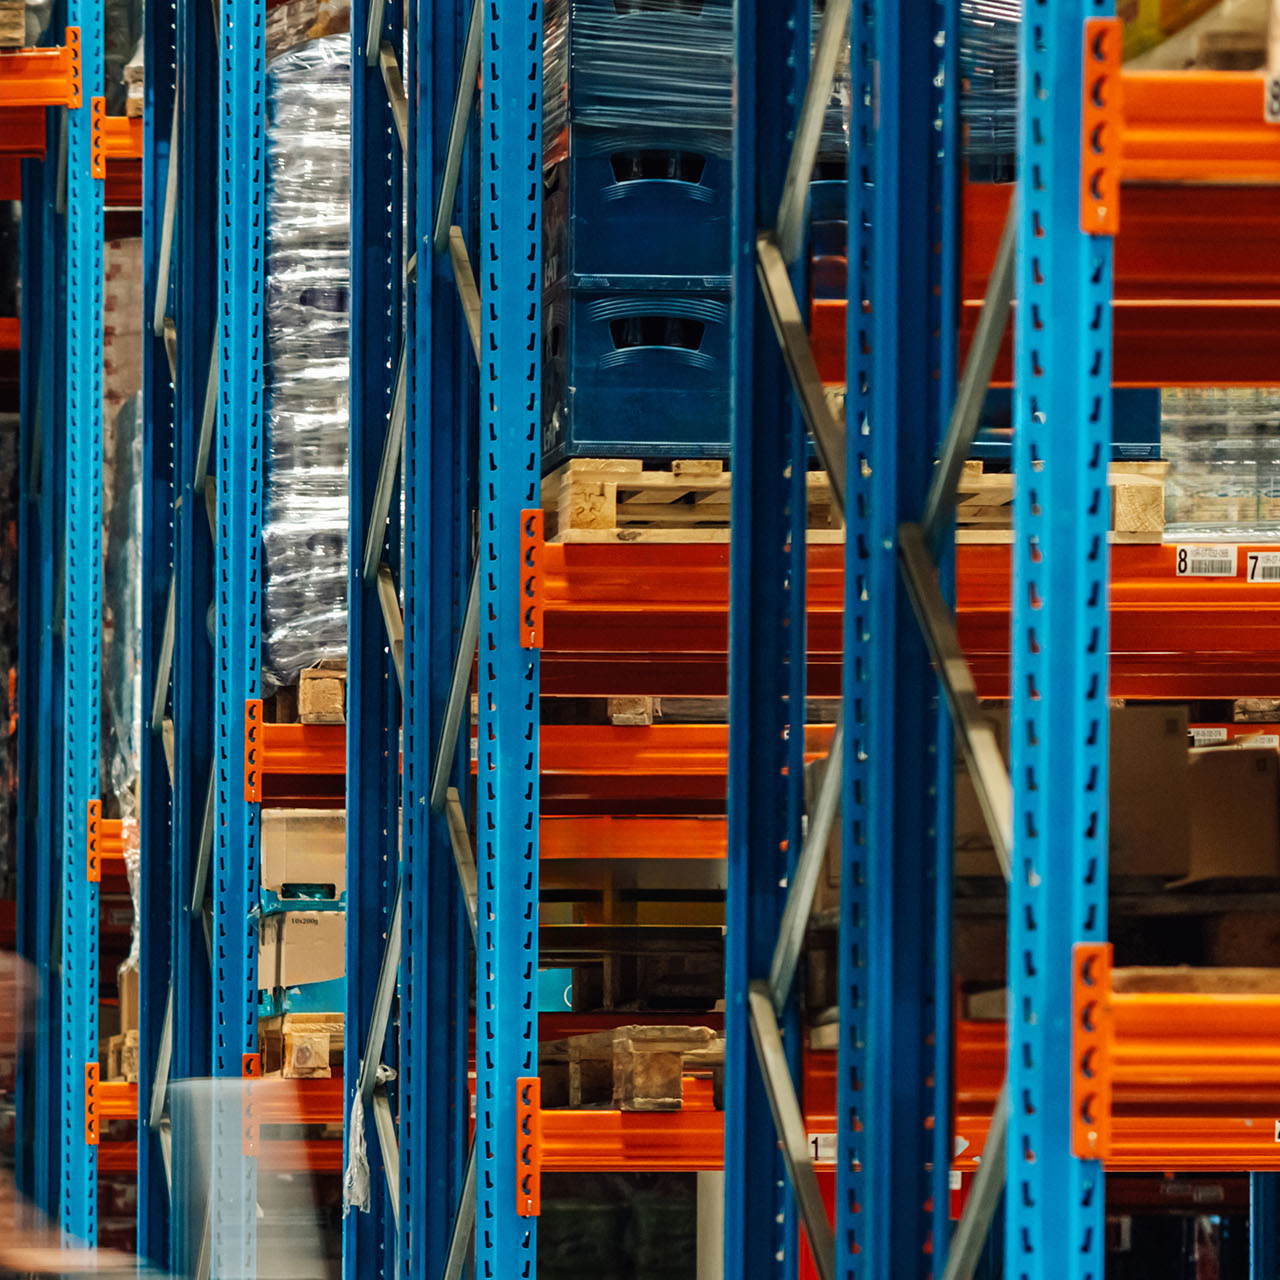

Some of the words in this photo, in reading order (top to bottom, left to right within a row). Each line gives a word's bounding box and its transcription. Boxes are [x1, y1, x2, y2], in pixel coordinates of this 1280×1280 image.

[1178, 549, 1188, 573] 8
[1249, 556, 1258, 580] 7
[811, 1137, 818, 1161] 1
